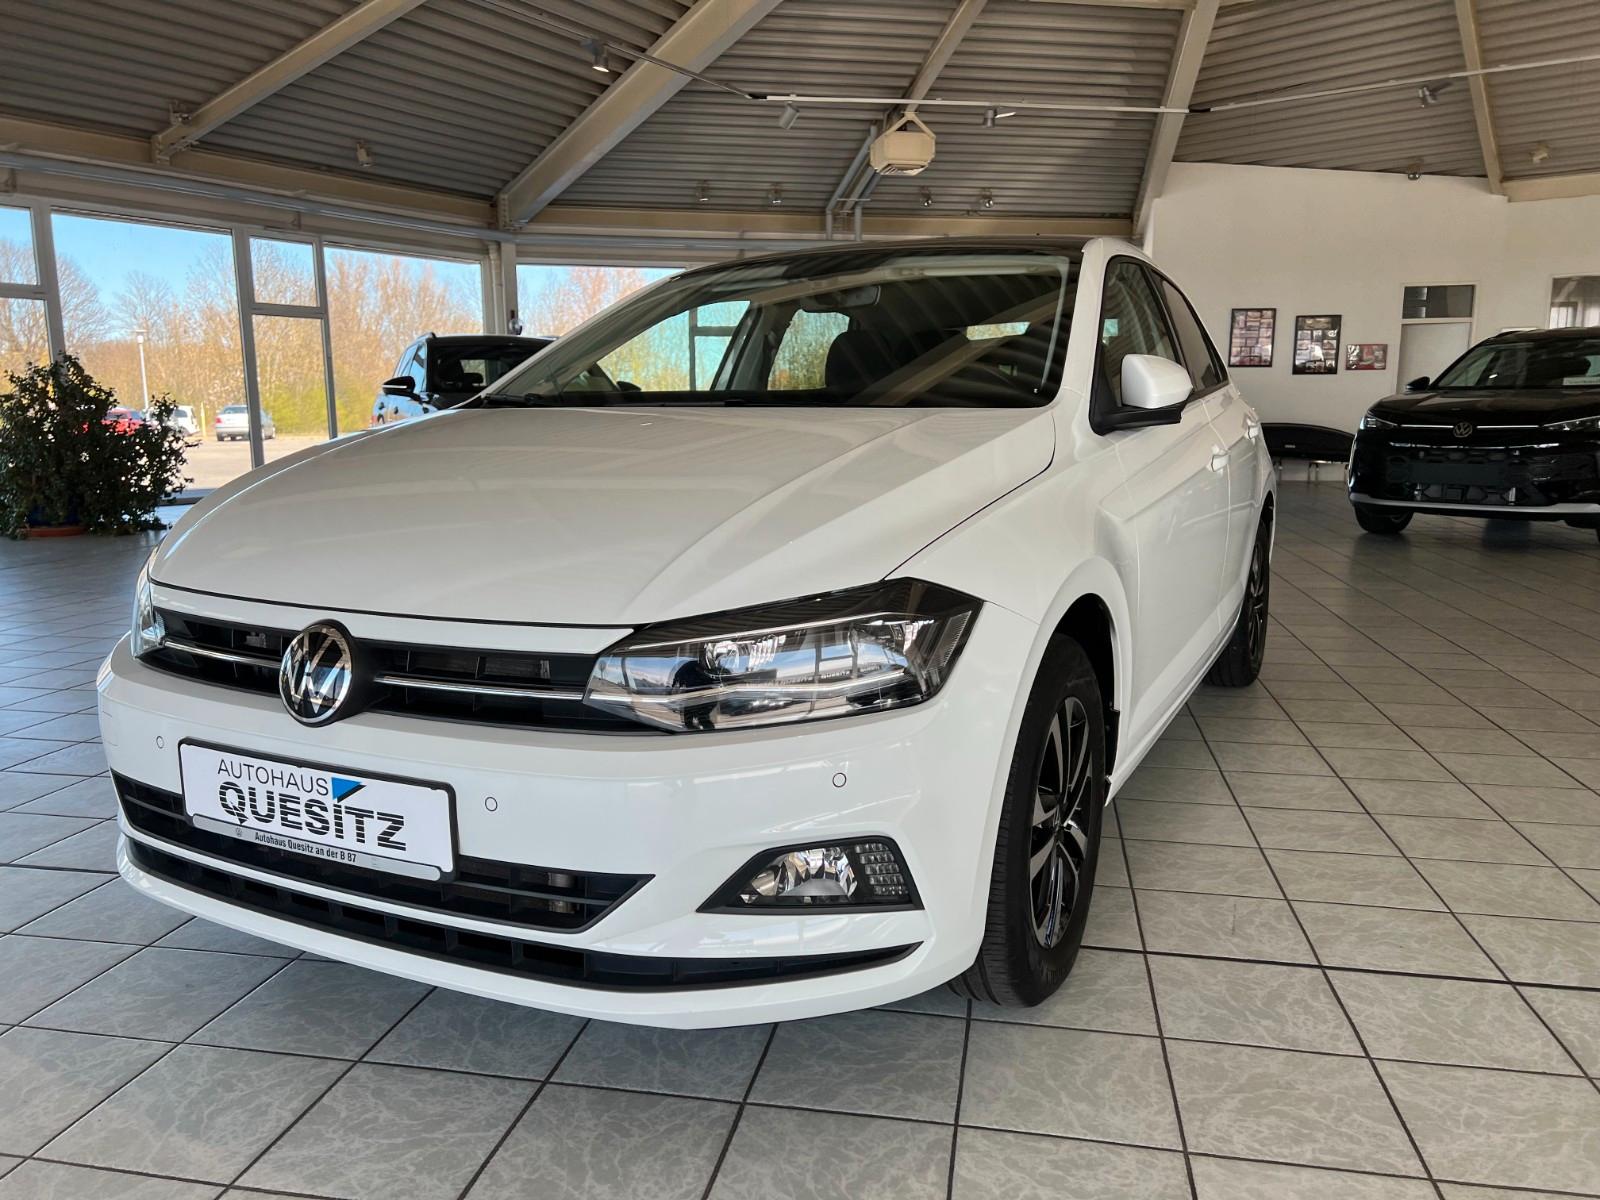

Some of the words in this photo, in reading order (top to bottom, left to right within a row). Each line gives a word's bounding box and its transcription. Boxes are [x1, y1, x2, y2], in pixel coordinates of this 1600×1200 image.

[217, 758, 329, 796] AUTOHAUS
[218, 781, 407, 851] QUESITZ
[255, 831, 287, 848] Autohaus
[287, 839, 314, 854] Quesitz
[315, 847, 325, 856] an
[326, 848, 338, 859] der
[340, 851, 346, 861] B
[347, 853, 357, 863] 87
